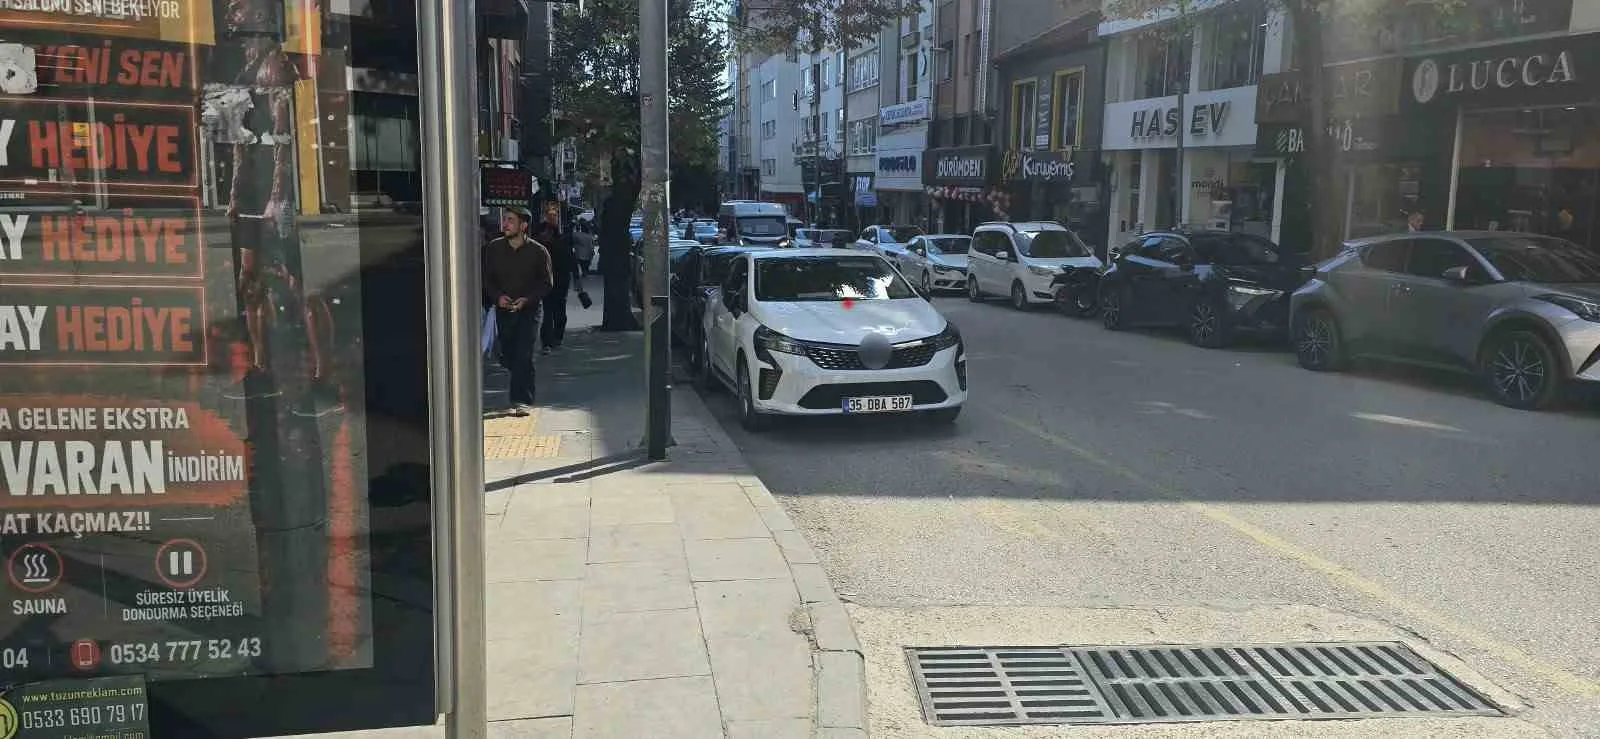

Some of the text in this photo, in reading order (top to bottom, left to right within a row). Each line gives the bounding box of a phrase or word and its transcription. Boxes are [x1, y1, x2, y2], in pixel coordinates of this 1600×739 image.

[117, 49, 184, 88] SEN
[1446, 50, 1576, 93] LUCCA
[28, 113, 182, 172] HEDİYE
[0, 208, 188, 264] Y HEDİYE
[56, 298, 194, 353] HEDİYE
[849, 399, 862, 411] 35
[891, 397, 911, 410] 587
[18, 407, 97, 431] GELENE
[103, 407, 190, 430] EKSTRA
[0, 439, 244, 496] VARAN İNDİRİM
[0, 511, 152, 539] AT KAÇMAZ!!
[12, 598, 68, 616] SAUNA
[135, 586, 231, 606] SÜRESİZ ÜYELİK
[122, 600, 244, 622] DONDURMA SEÇENEĞİ
[3, 637, 262, 669] 04 0534 777 52 43
[22, 686, 142, 704] www.tuzunreklam.com
[23, 708, 65, 729] 0533
[70, 706, 101, 726] 690
[106, 704, 126, 723] 79
[131, 703, 144, 721] 17
